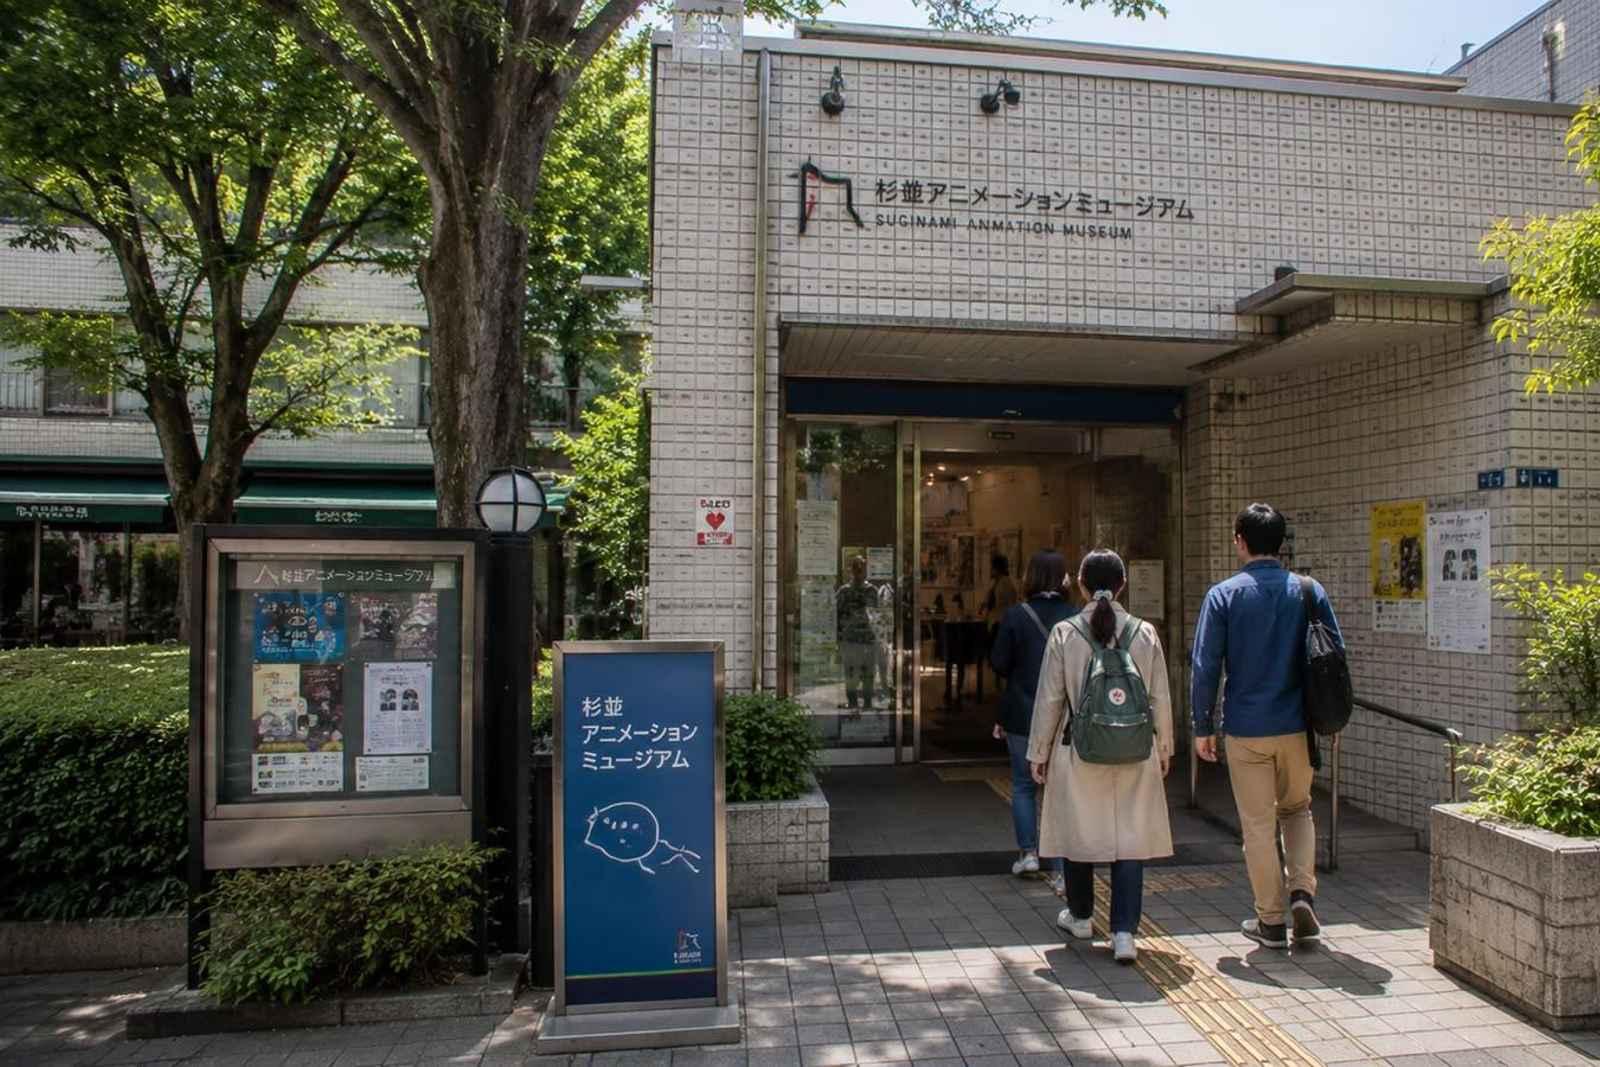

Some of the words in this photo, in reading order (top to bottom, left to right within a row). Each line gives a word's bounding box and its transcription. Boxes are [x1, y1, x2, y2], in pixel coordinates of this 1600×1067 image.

[875, 178, 1194, 219] 杉並アニメーションミュージアム
[875, 213, 957, 229] SUGINAMI
[1063, 223, 1132, 239] MUSEUM
[582, 696, 623, 718] 杉並
[582, 723, 698, 744] アニメーション
[582, 748, 690, 770] ミュージアム
